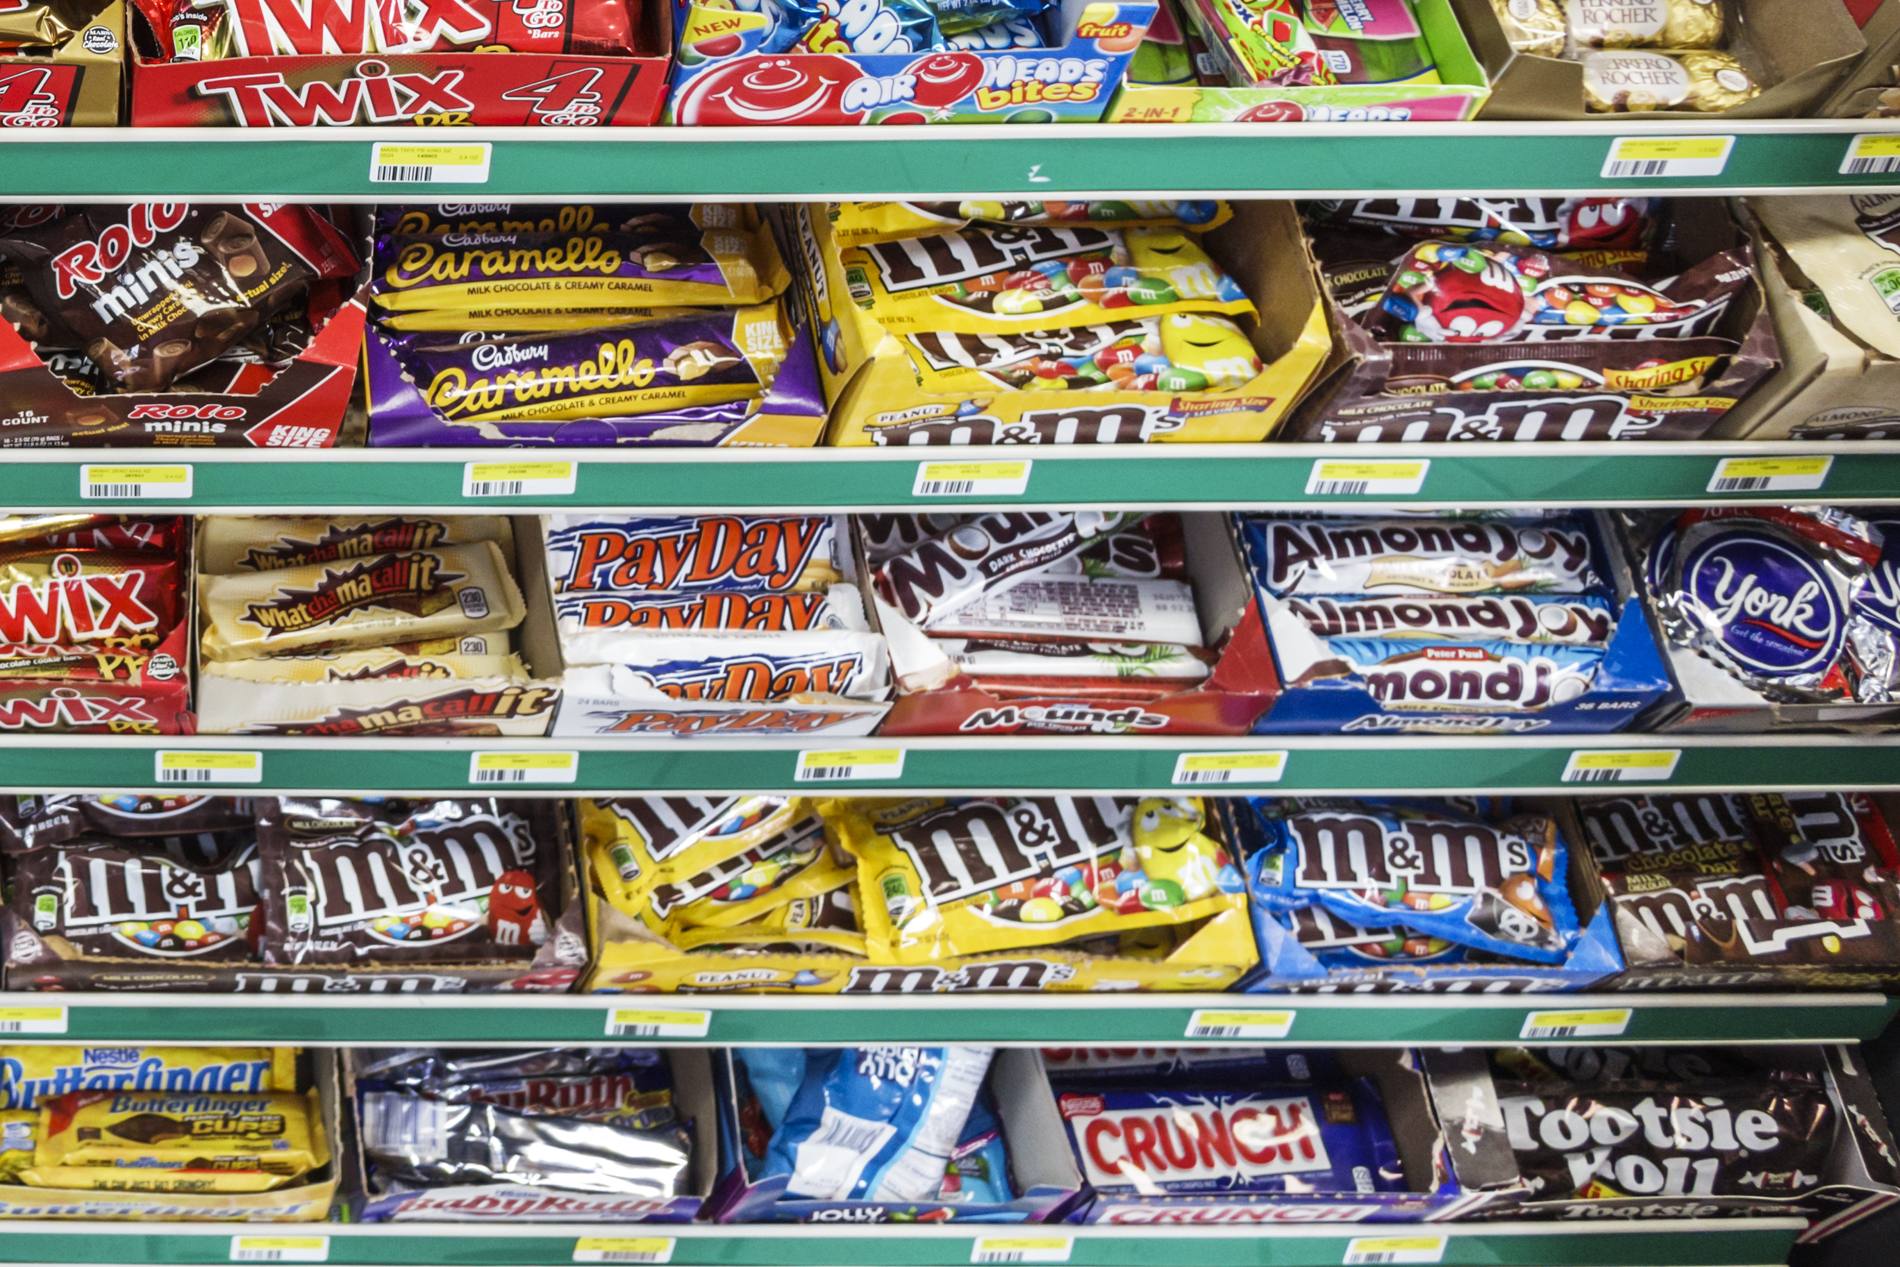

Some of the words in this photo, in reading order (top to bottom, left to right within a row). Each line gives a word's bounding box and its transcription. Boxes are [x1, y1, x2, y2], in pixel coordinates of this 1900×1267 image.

[693, 17, 741, 36] NEW
[1581, 6, 1658, 25] ROCHER
[841, 75, 918, 112] AIR
[985, 56, 1110, 84] HEADS
[975, 80, 1100, 111] bites
[467, 285, 490, 294] MILK
[492, 283, 549, 294] CHOCOLATE
[565, 282, 604, 292] CREAMY
[607, 282, 654, 293] CARAMEL
[471, 341, 549, 372] Cadbury
[427, 340, 657, 417] Caramello
[127, 403, 248, 421] Rolo
[145, 418, 227, 434] minis
[879, 404, 943, 423] PEANUT
[568, 516, 826, 592] PayDay
[1268, 523, 1498, 591] Almond
[1498, 525, 1590, 572] Joy
[252, 552, 442, 635] Whatchamacallit
[1709, 556, 1816, 631] York
[1426, 648, 1453, 660] Peter
[1456, 648, 1484, 660] Paul
[959, 706, 1170, 732] Mounds
[1083, 1100, 1319, 1177] CRUNCH
[1501, 1098, 1780, 1155] Tootsie
